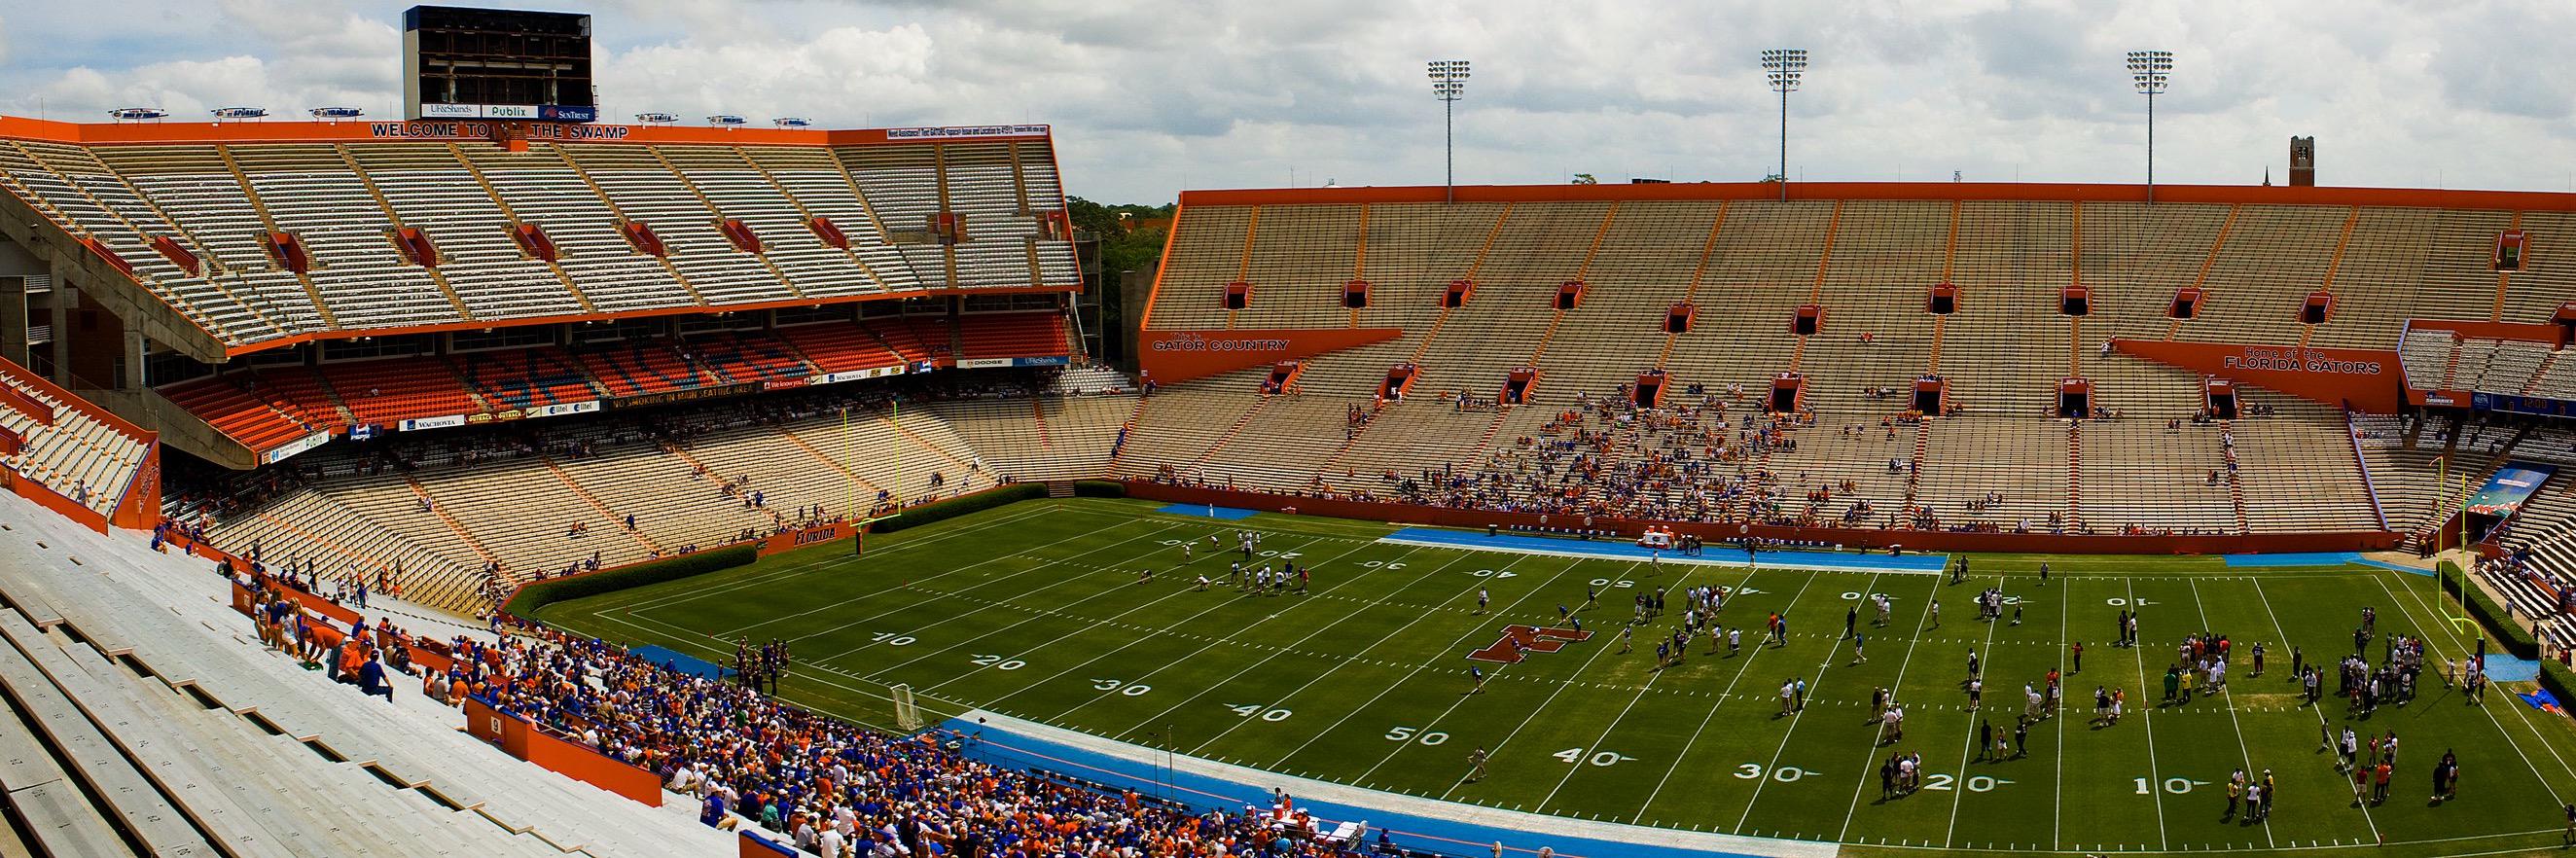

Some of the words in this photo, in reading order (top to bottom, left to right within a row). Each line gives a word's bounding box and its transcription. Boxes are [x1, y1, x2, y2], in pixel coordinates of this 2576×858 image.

[492, 106, 526, 117] Publix
[371, 122, 459, 138] WELCOME
[465, 123, 488, 137] TO
[530, 123, 564, 138] THE
[570, 125, 628, 139] SWAMP
[1153, 340, 1206, 351] GATOR
[1210, 340, 1290, 351] COUNTRY
[2245, 346, 2278, 358] Home
[2285, 349, 2298, 359] of
[2224, 357, 2302, 371] FLORIDA
[2306, 361, 2381, 375] GATORS
[613, 399, 625, 409] NO
[627, 396, 664, 407] SMOKING
[666, 394, 675, 403] IN
[677, 391, 698, 401] MAIN
[699, 387, 732, 399] SEATING
[418, 419, 455, 428] WACHOVIA
[795, 527, 837, 546] FLORIDA
[971, 654, 1026, 670] 20
[1093, 679, 1152, 697] 30
[1232, 703, 1293, 722] 40
[1384, 727, 1449, 746] 50
[1552, 747, 1622, 767] 40
[1734, 763, 1804, 782] 30
[1923, 773, 1996, 793] 20
[2133, 777, 2193, 794] 10
